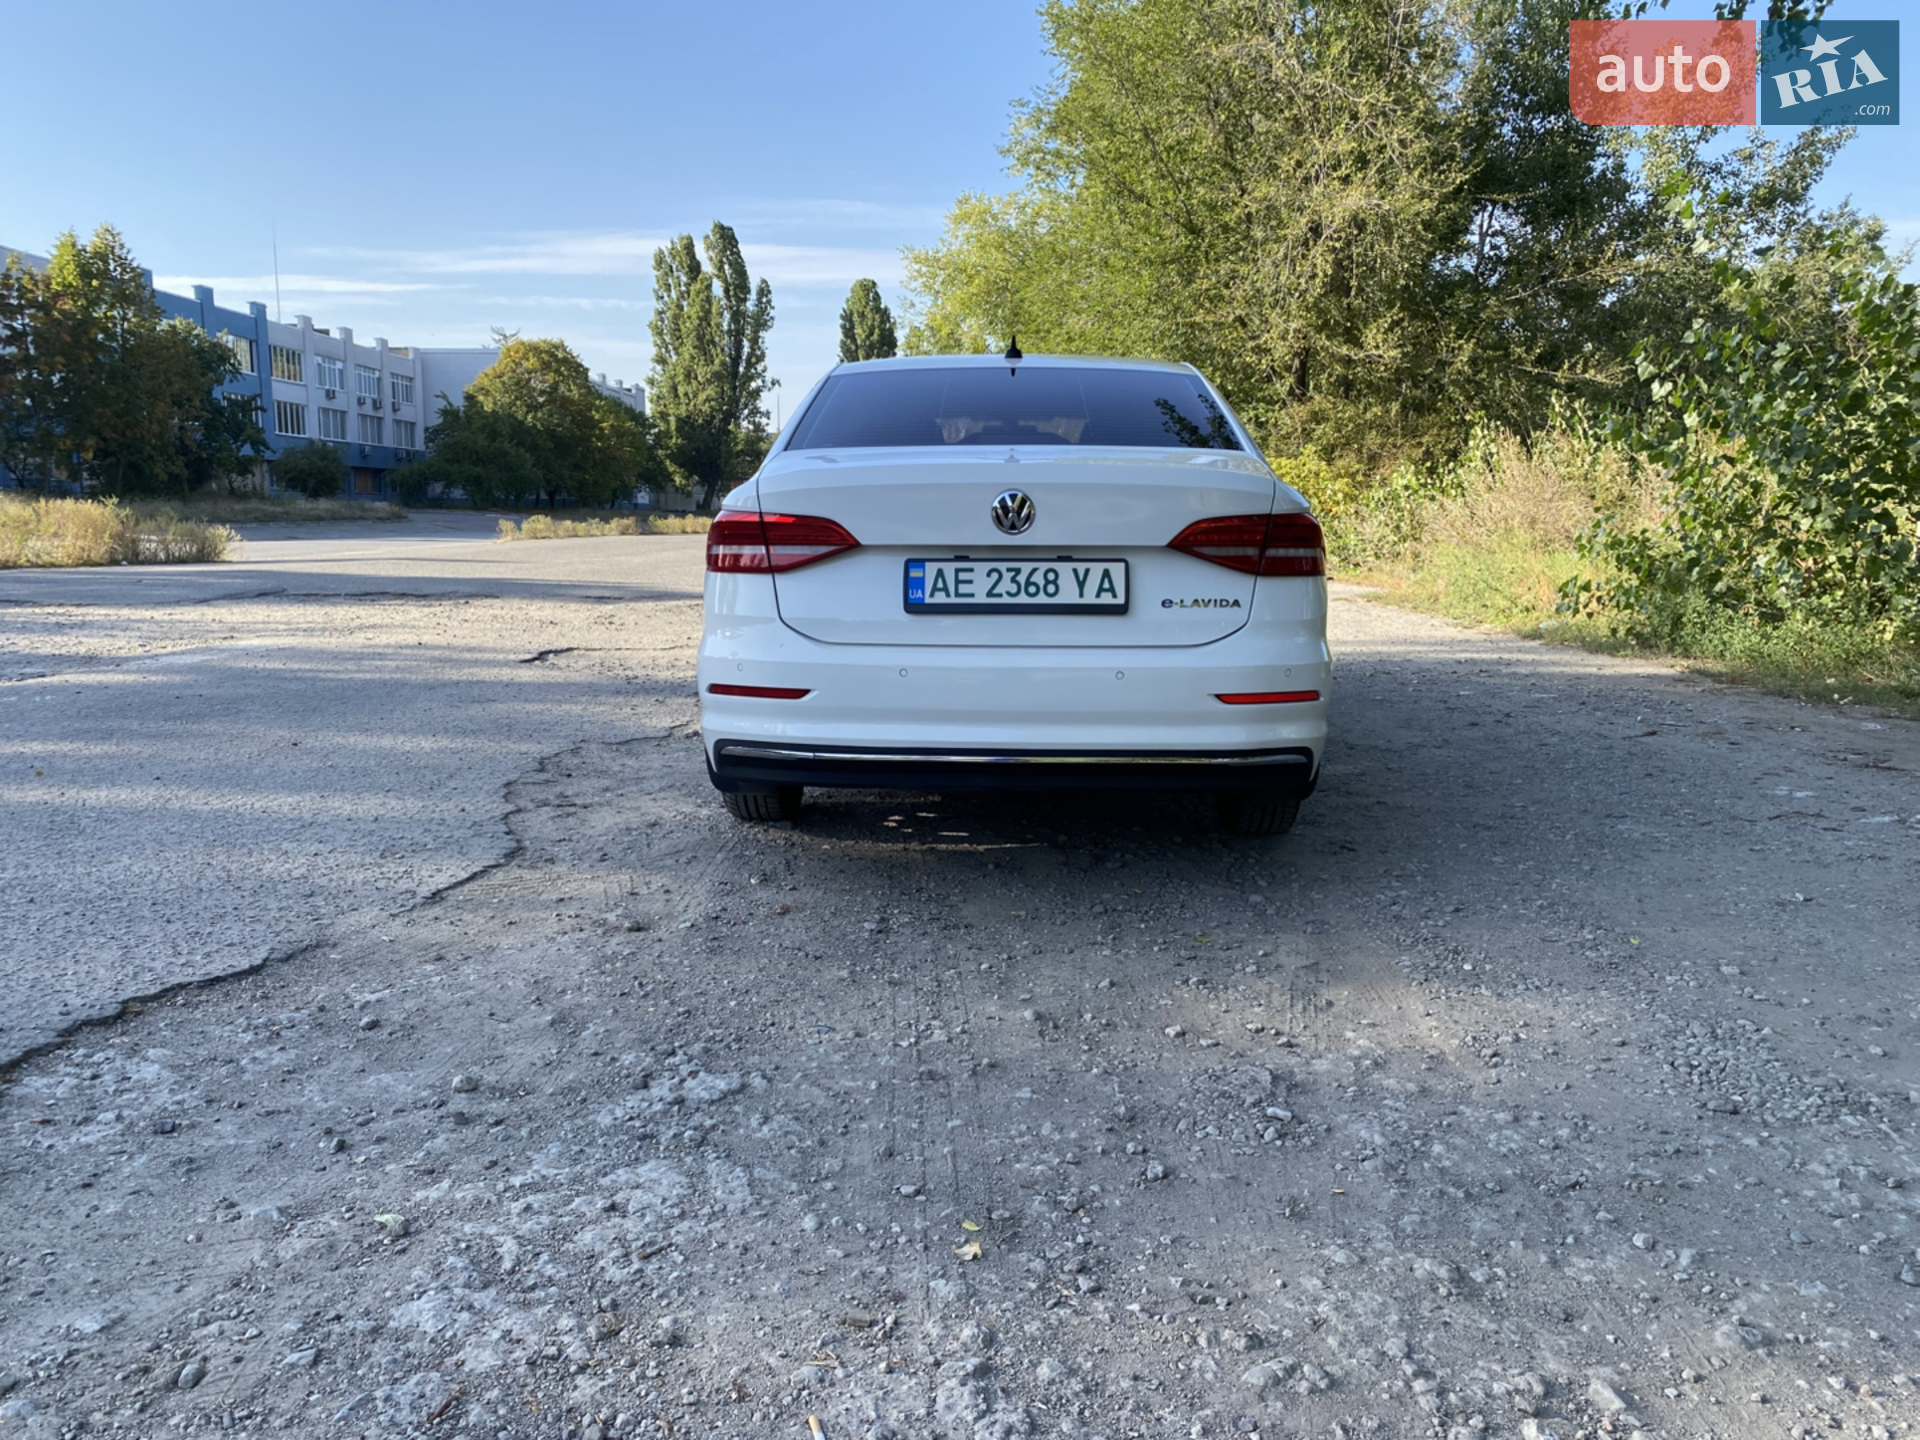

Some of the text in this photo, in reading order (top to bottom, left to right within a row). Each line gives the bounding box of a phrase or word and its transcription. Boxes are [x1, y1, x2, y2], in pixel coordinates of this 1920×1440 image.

[928, 567, 1118, 599] AE 2368 YA
[909, 588, 924, 599] UA
[1160, 597, 1242, 609] e-LAVIDA
